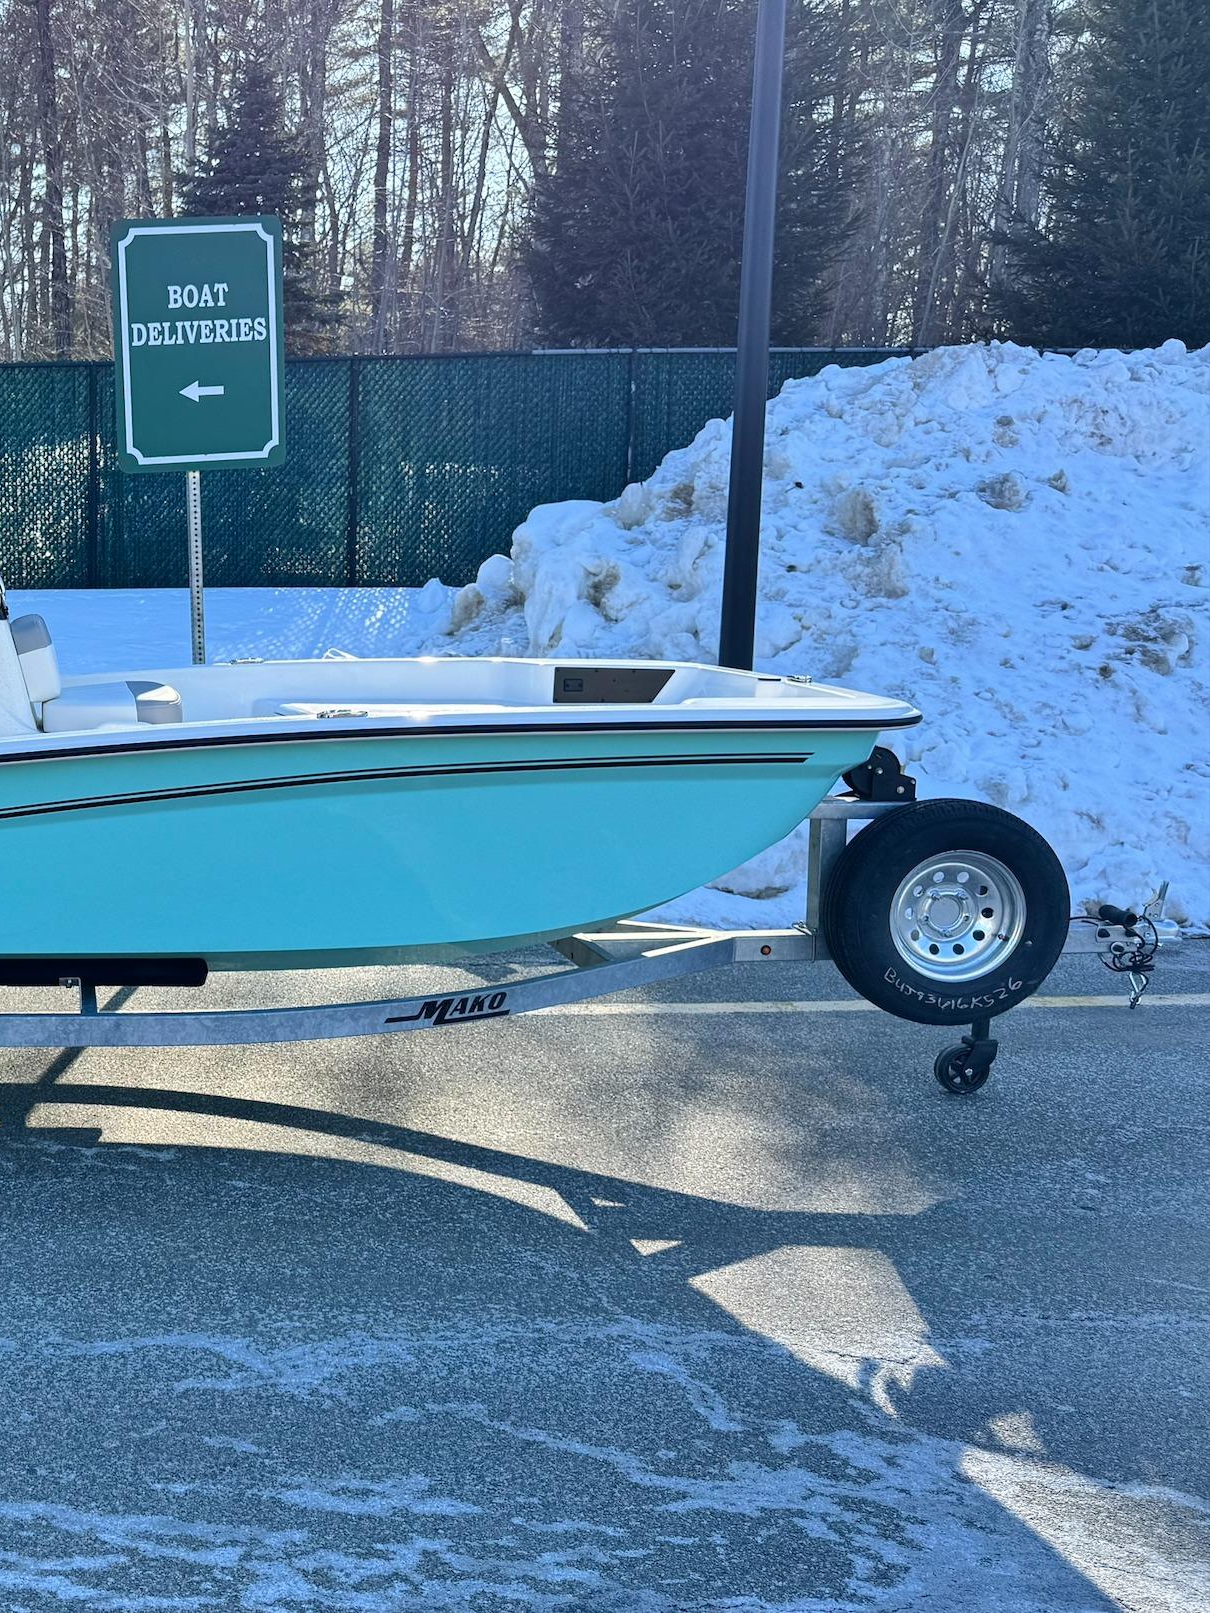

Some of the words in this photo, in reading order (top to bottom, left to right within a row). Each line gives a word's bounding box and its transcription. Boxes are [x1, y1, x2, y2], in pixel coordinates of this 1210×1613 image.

[167, 283, 229, 309] BOAT
[131, 317, 268, 346] DELIVERIES
[384, 991, 511, 1025] MAKO
